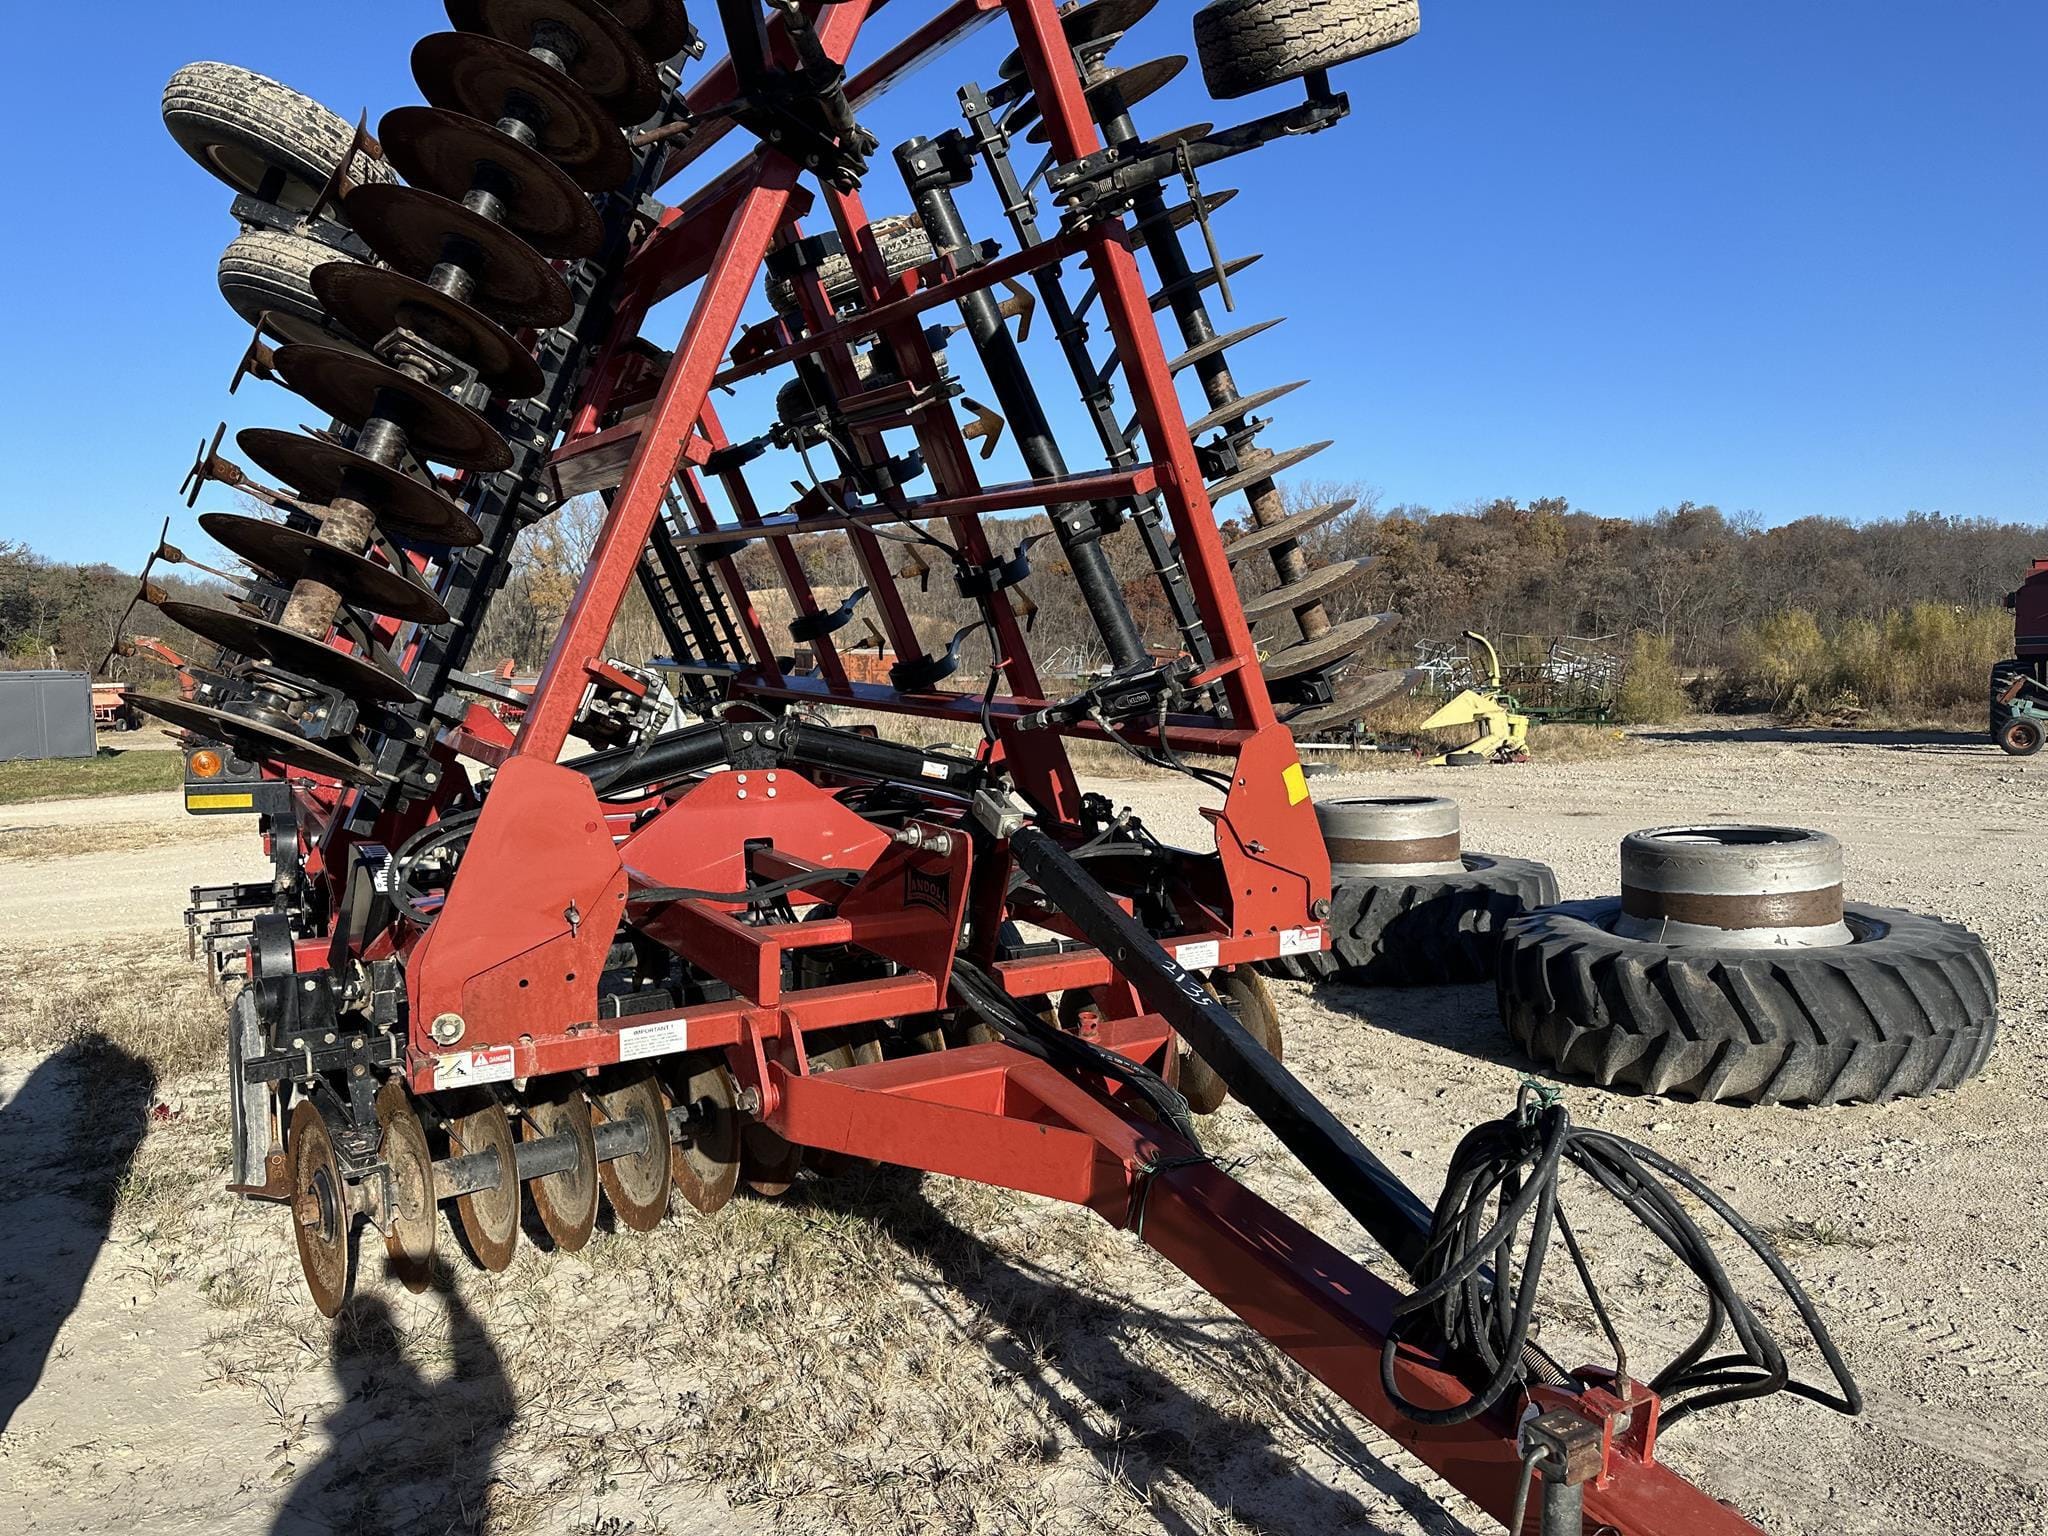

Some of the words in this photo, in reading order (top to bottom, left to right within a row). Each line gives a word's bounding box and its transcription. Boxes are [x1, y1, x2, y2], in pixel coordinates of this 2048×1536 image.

[1161, 960, 1213, 1006] 2135
[633, 1025, 669, 1036] IMPORTANT
[488, 1054, 510, 1063] DANGER
